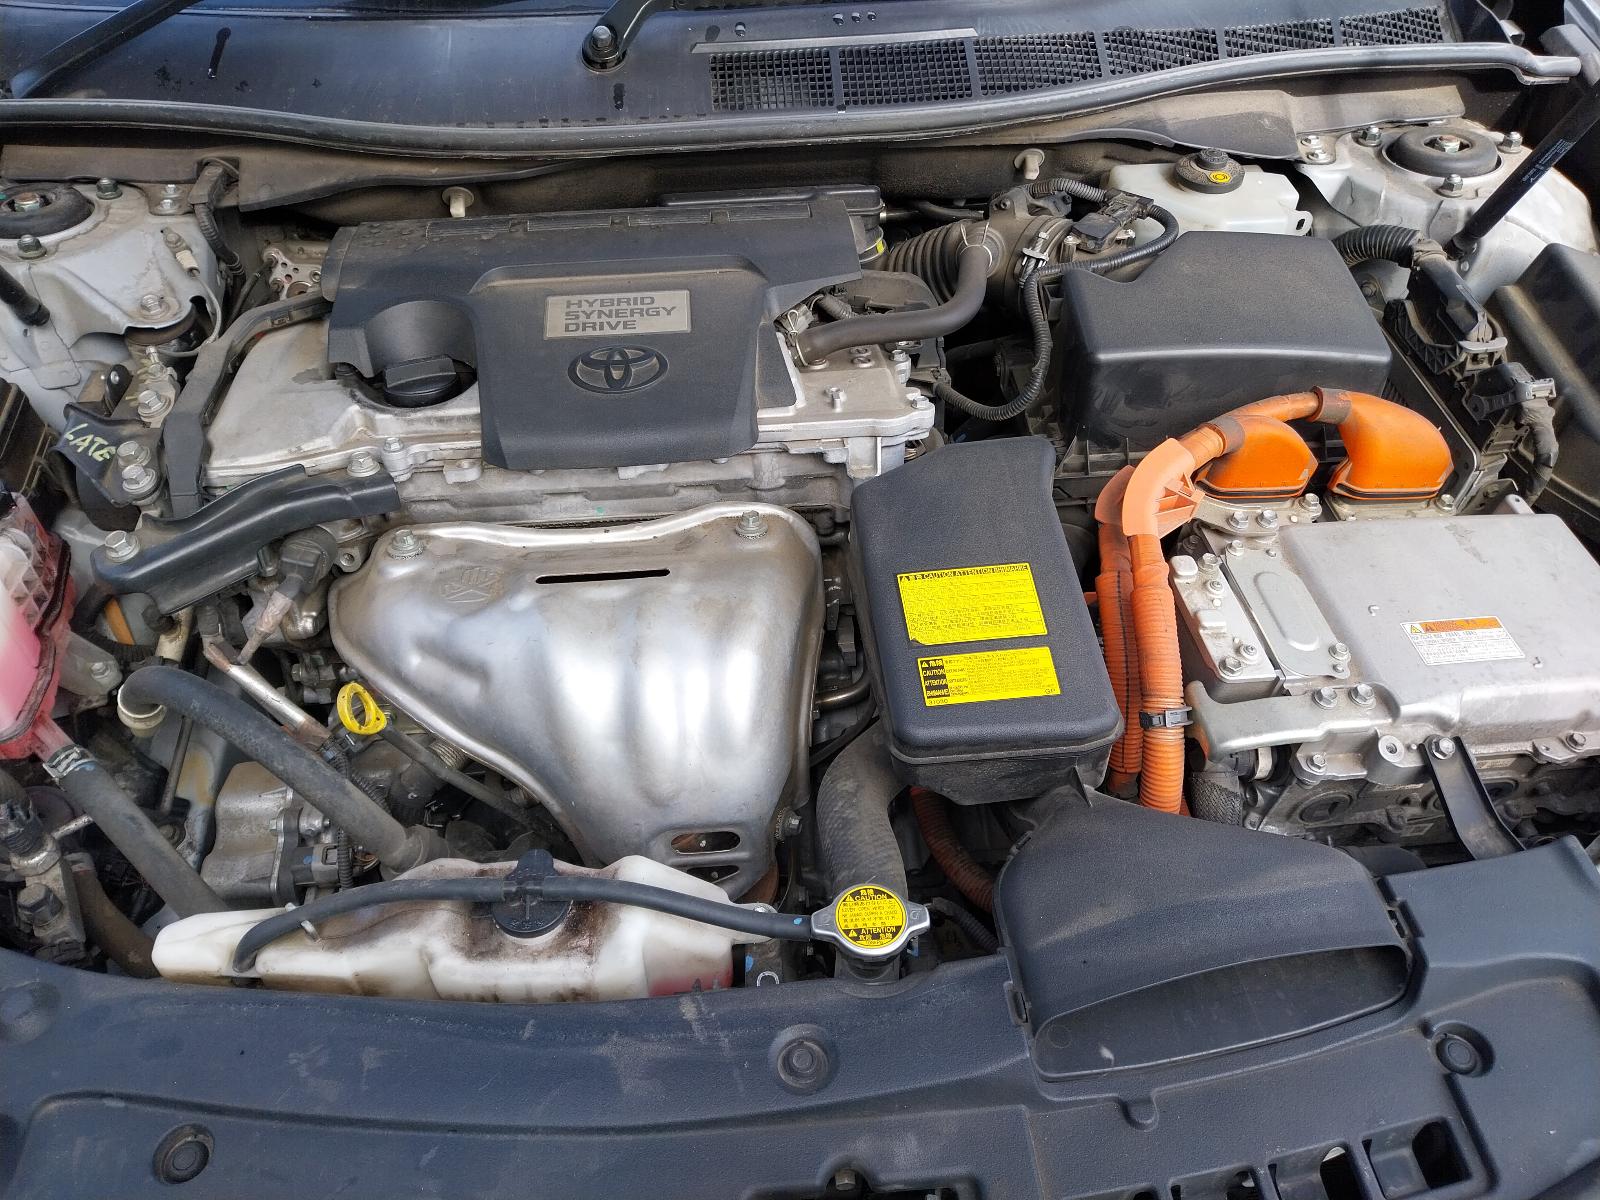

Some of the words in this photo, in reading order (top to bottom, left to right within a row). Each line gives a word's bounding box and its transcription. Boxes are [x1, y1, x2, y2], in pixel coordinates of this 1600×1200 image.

[566, 296, 655, 309] HYBRID
[565, 306, 677, 321] SYNERGY
[564, 320, 637, 333] DRIVE
[923, 570, 954, 580] CAUTION
[955, 567, 993, 577] ATTENTION
[922, 669, 946, 677] CAUTION
[861, 926, 896, 934] ATTENTION
